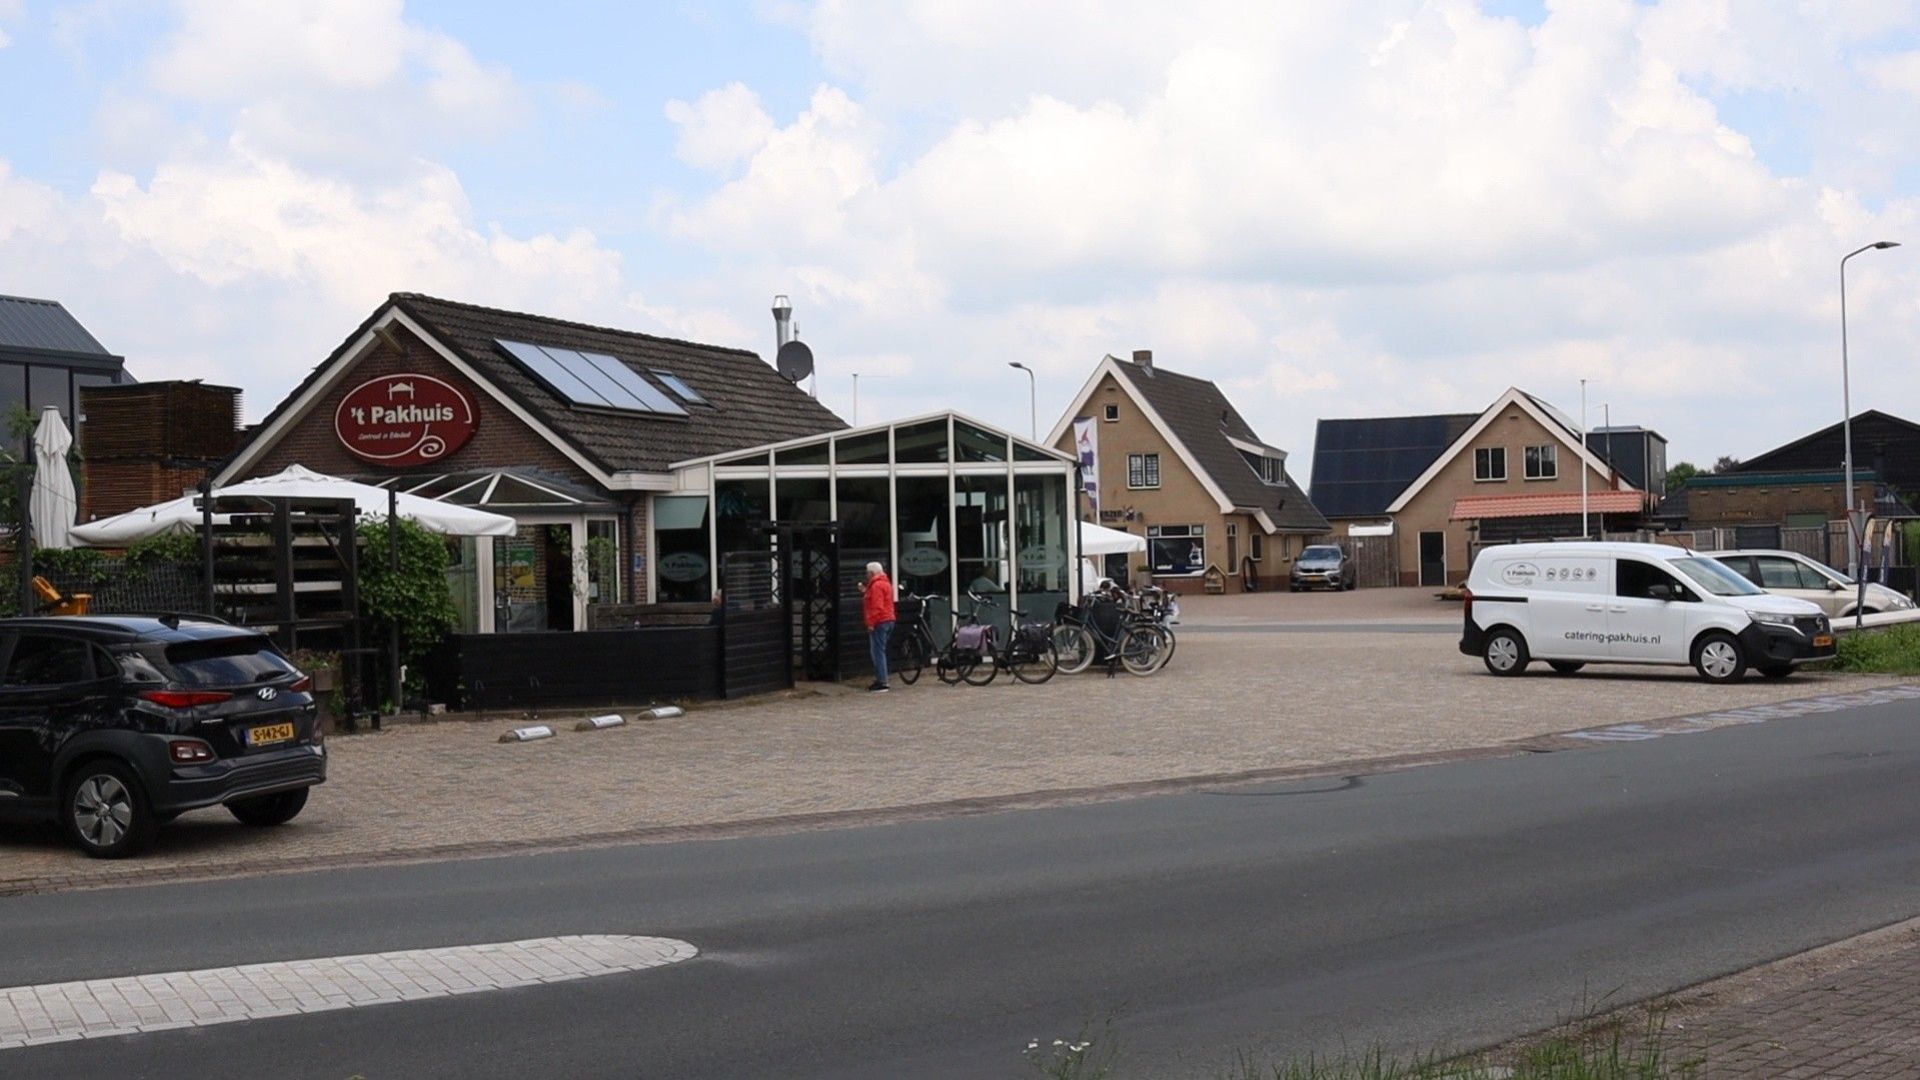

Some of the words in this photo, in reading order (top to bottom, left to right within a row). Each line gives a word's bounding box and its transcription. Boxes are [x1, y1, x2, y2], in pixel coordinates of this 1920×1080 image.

[350, 406, 365, 425] 't
[371, 402, 454, 424] Pakhuis
[1564, 631, 1661, 645] catering-pakhuis.nl
